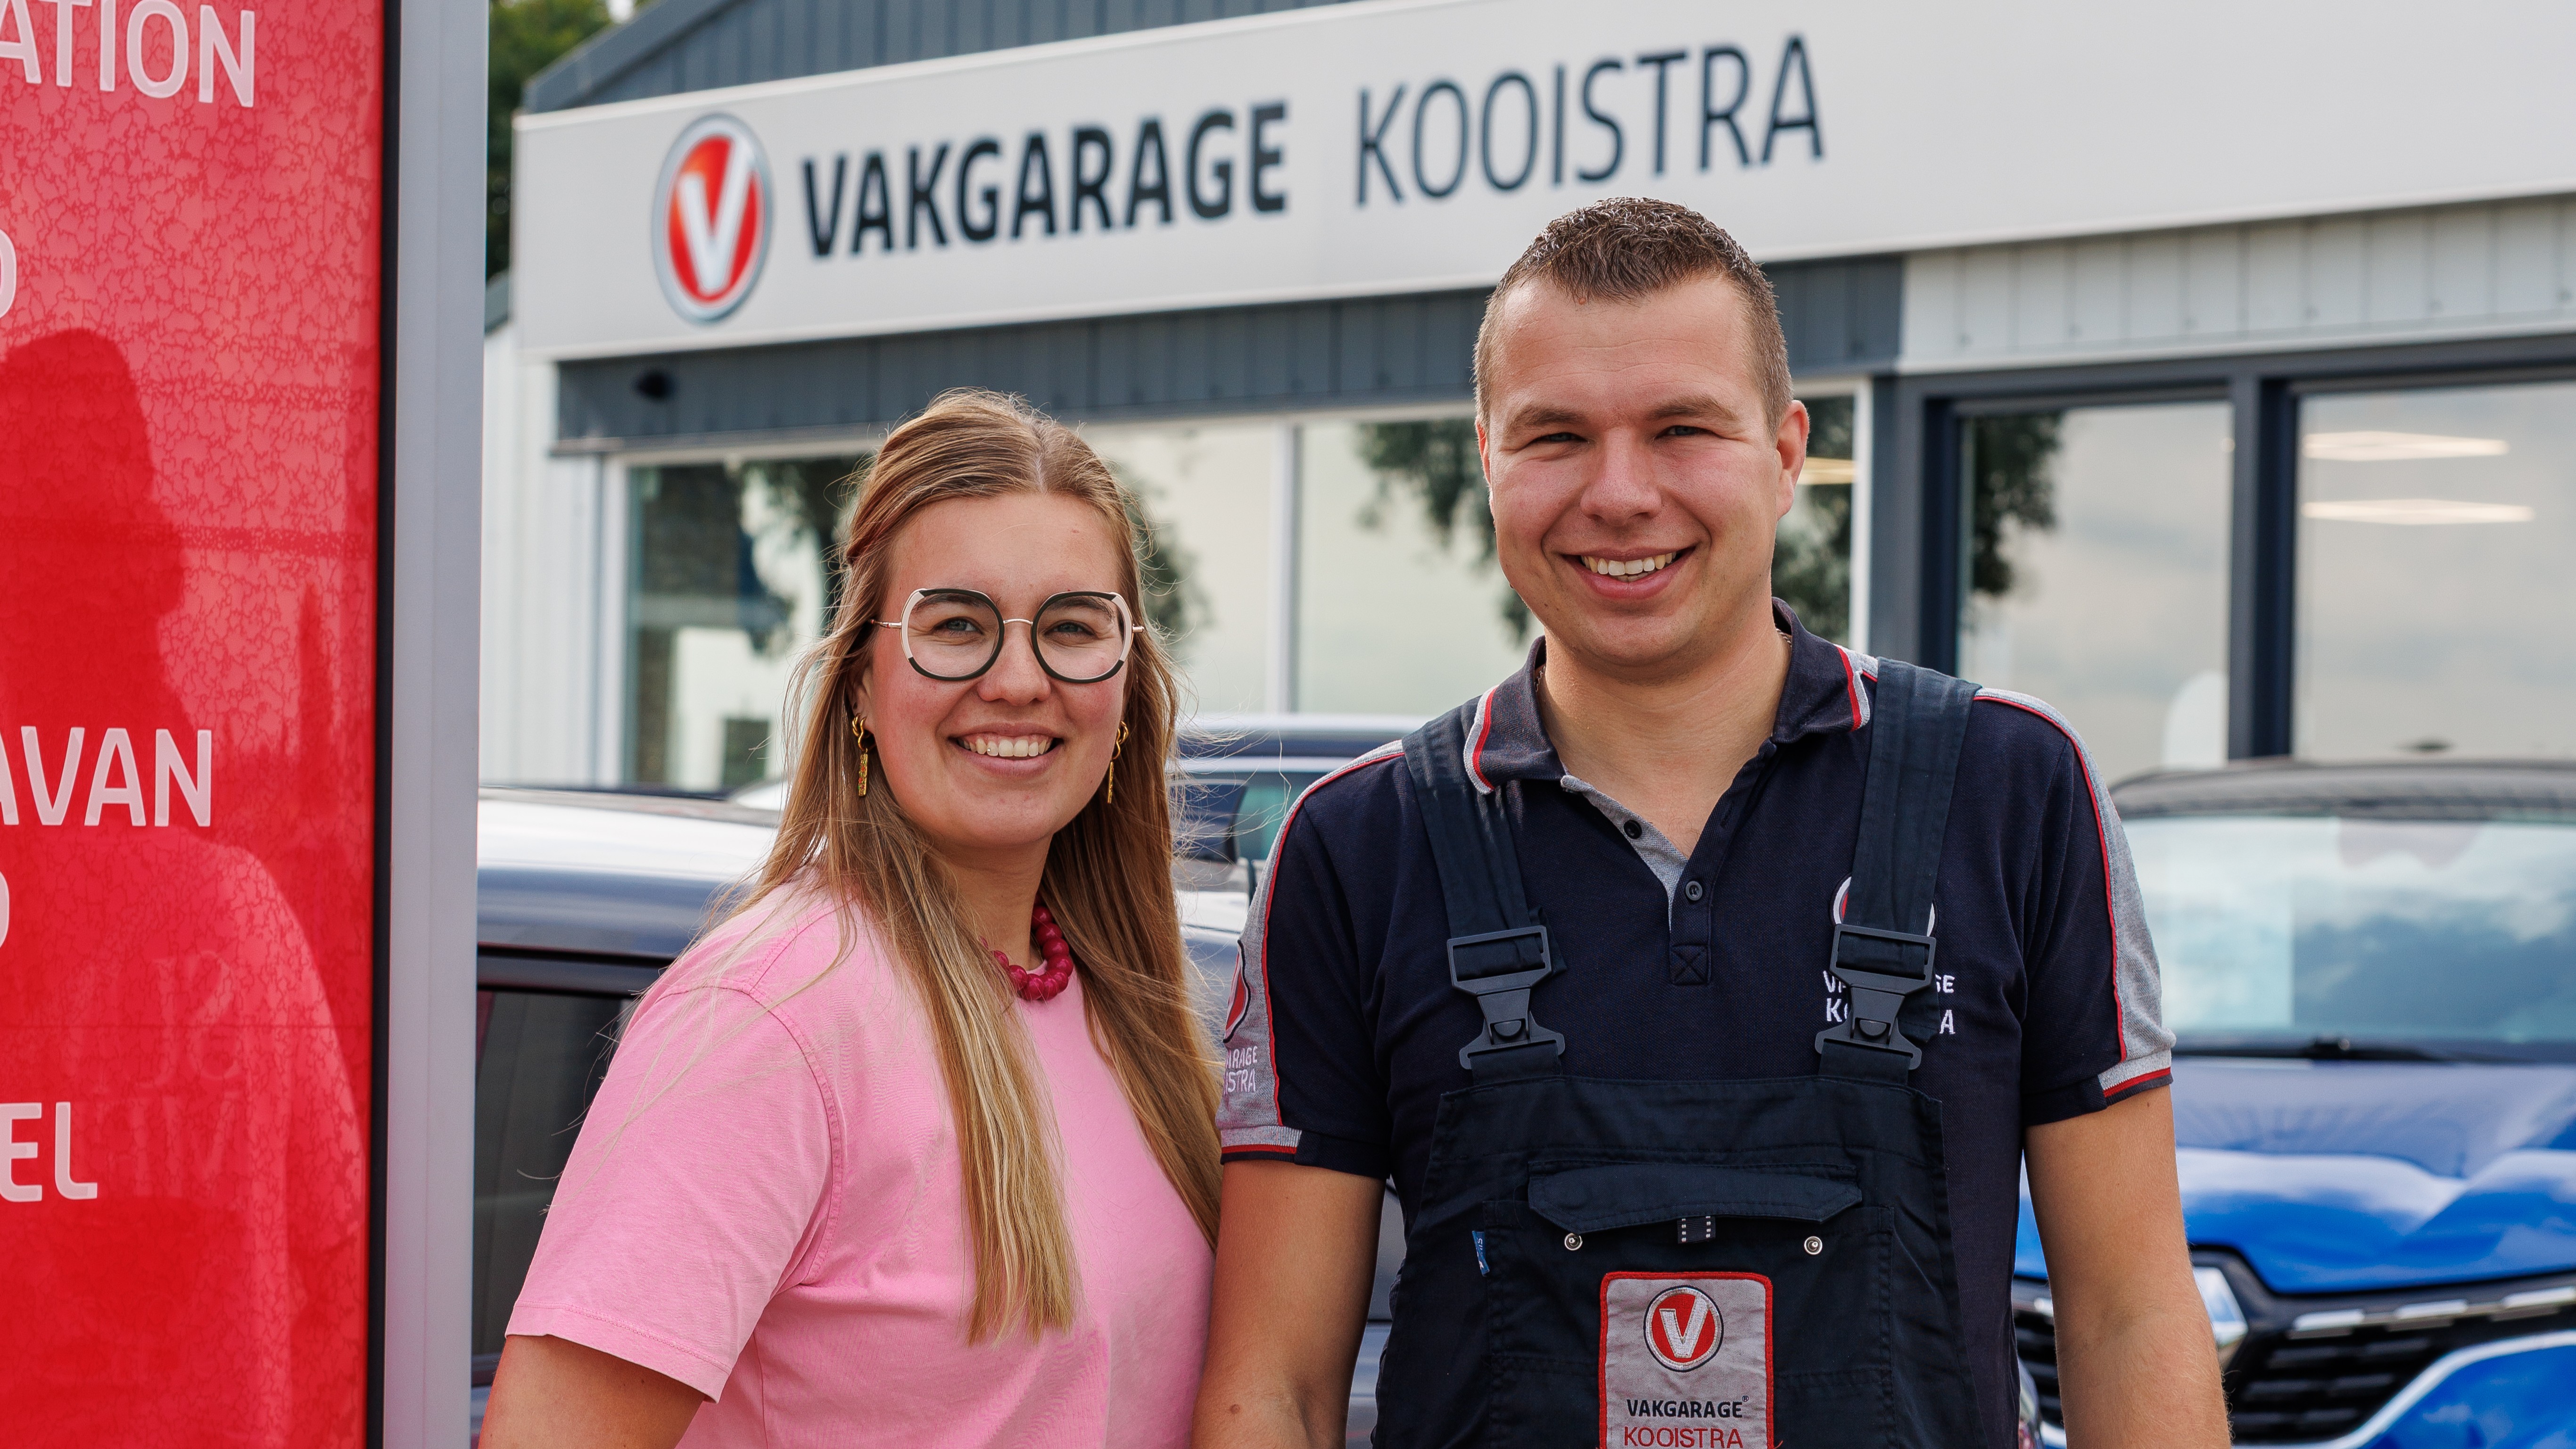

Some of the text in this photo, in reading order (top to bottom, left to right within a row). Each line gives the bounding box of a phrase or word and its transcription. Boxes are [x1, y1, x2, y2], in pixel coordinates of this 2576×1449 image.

[801, 34, 1826, 261] VAKGARAGE KOOISTRA
[675, 138, 760, 294] V
[1223, 1068, 1256, 1095] ISTRA
[0, 1101, 98, 1202] EL
[1659, 1293, 1709, 1358] V
[1624, 1426, 1743, 1449] KOOISTRA
